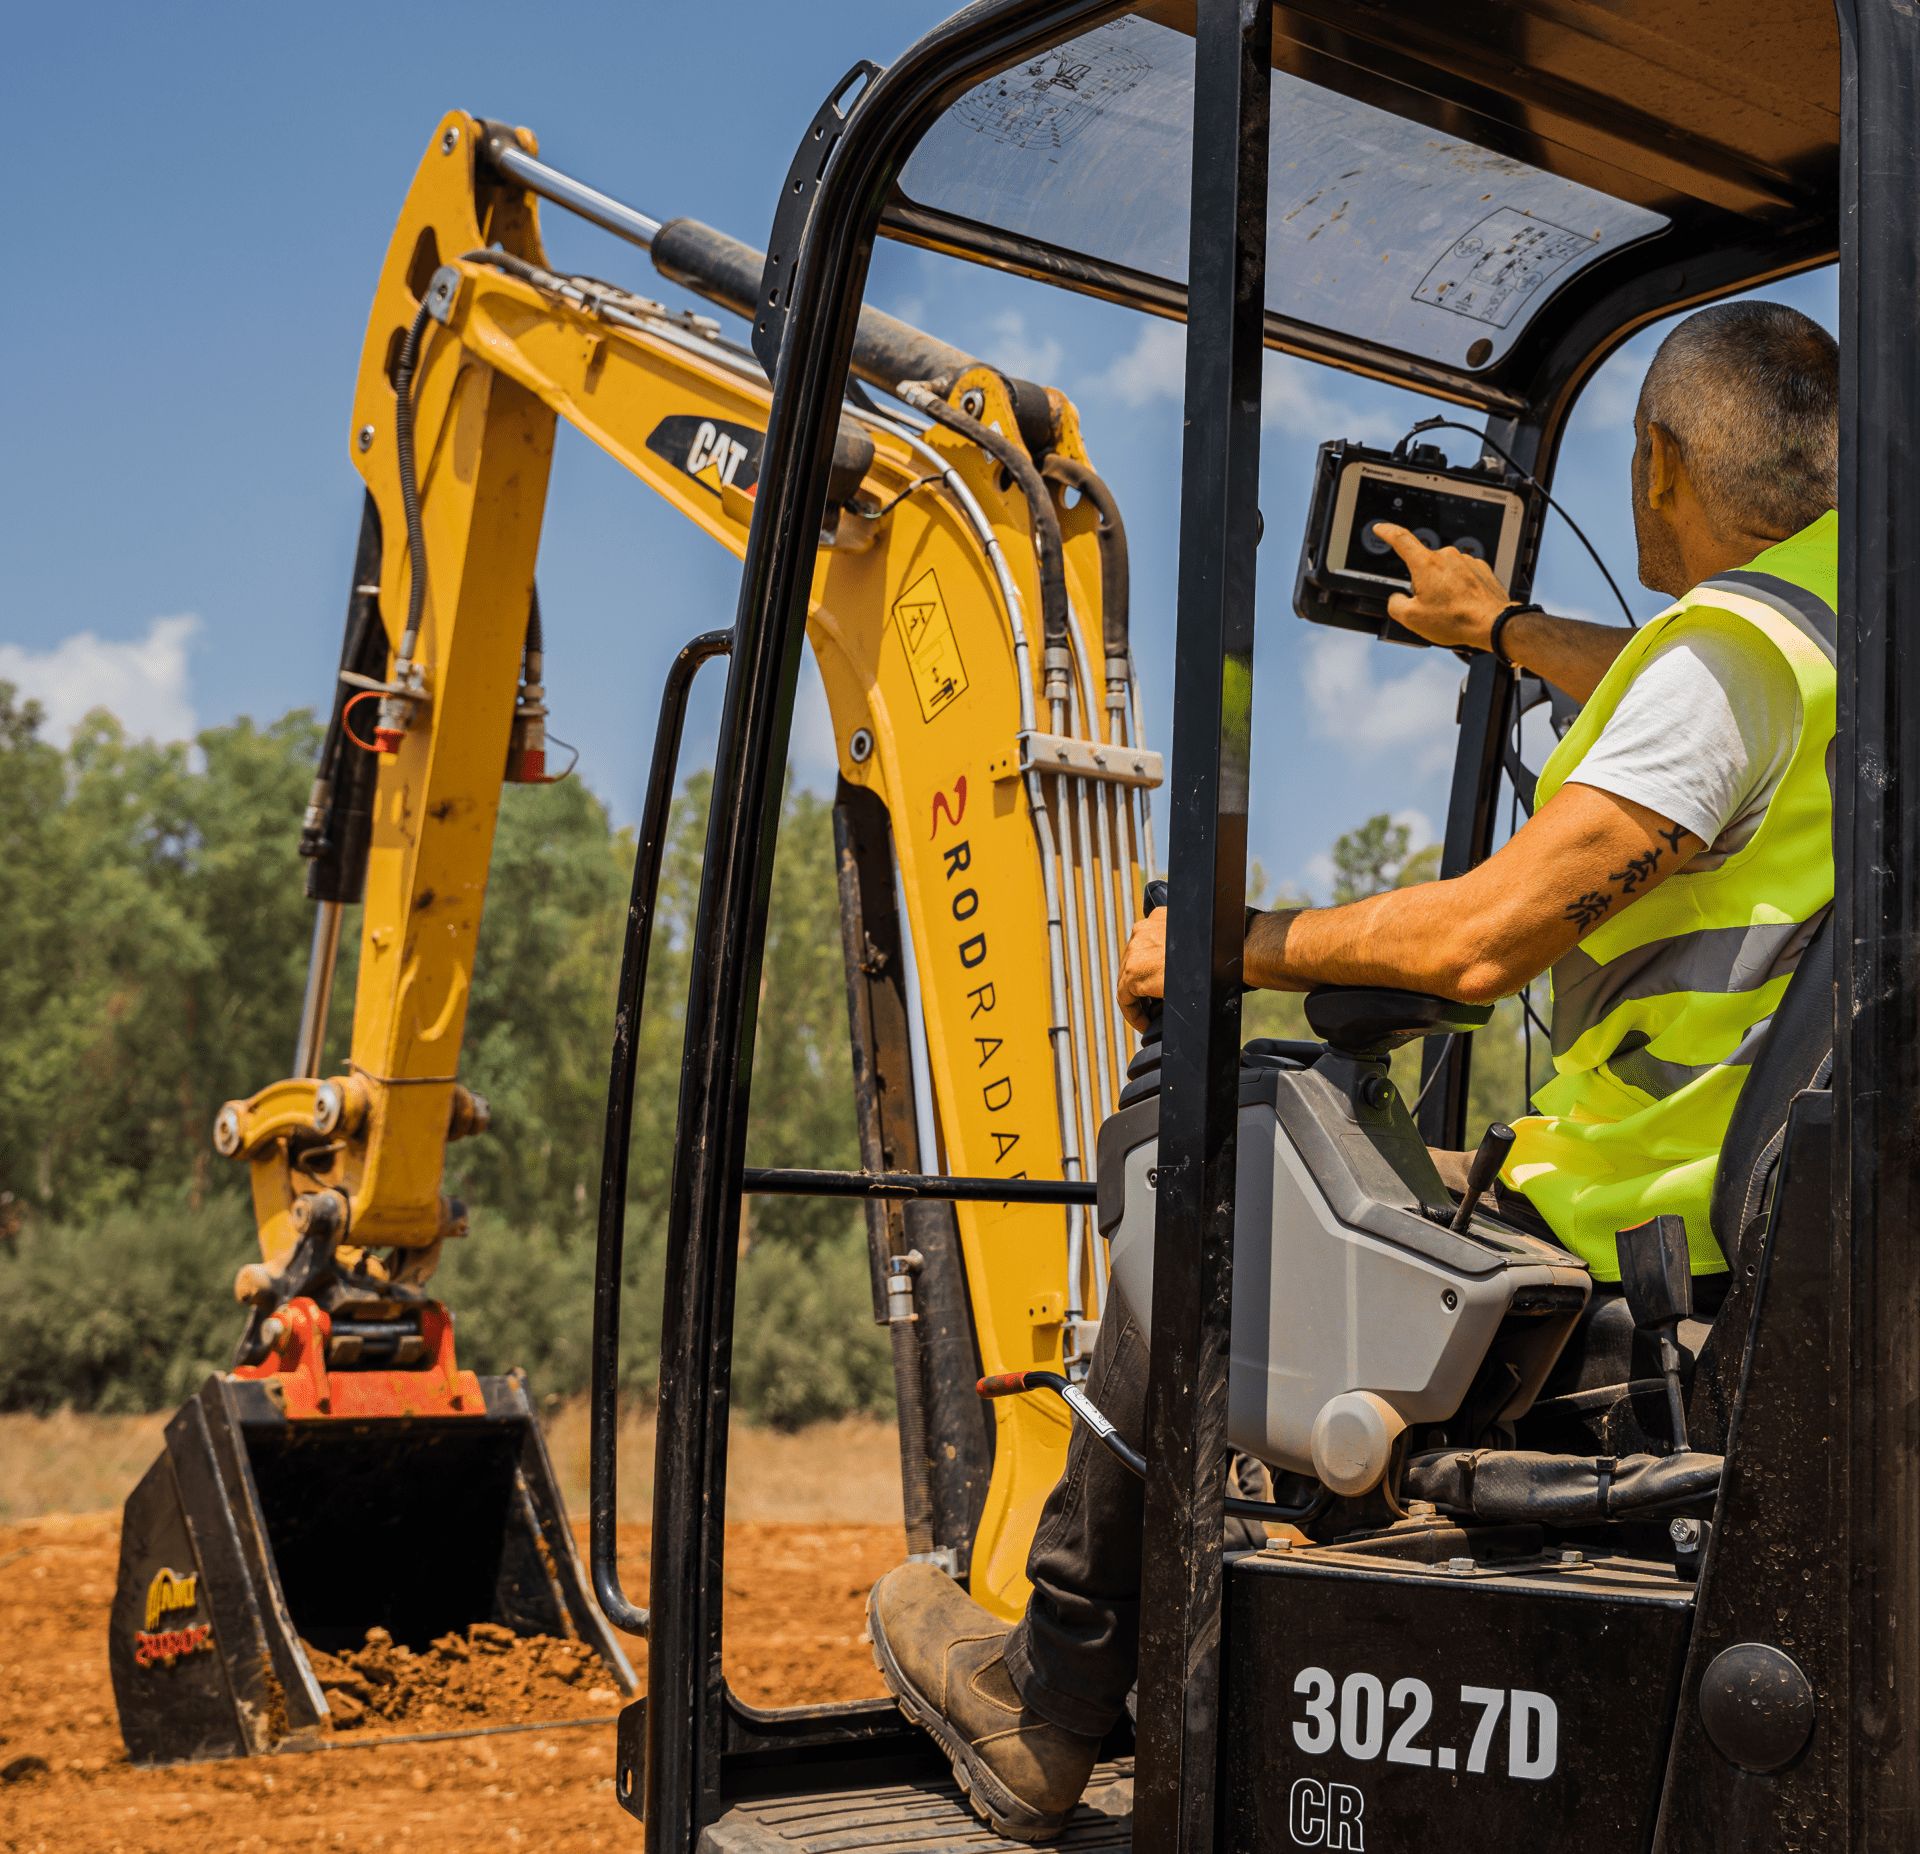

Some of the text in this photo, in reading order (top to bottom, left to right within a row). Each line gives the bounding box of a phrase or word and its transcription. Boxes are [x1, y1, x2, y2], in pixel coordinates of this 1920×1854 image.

[686, 421, 749, 487] CAT
[1361, 466, 1393, 478] Panasonic
[1292, 1666, 1558, 1780] 302.7D
[1289, 1777, 1365, 1852] CR
